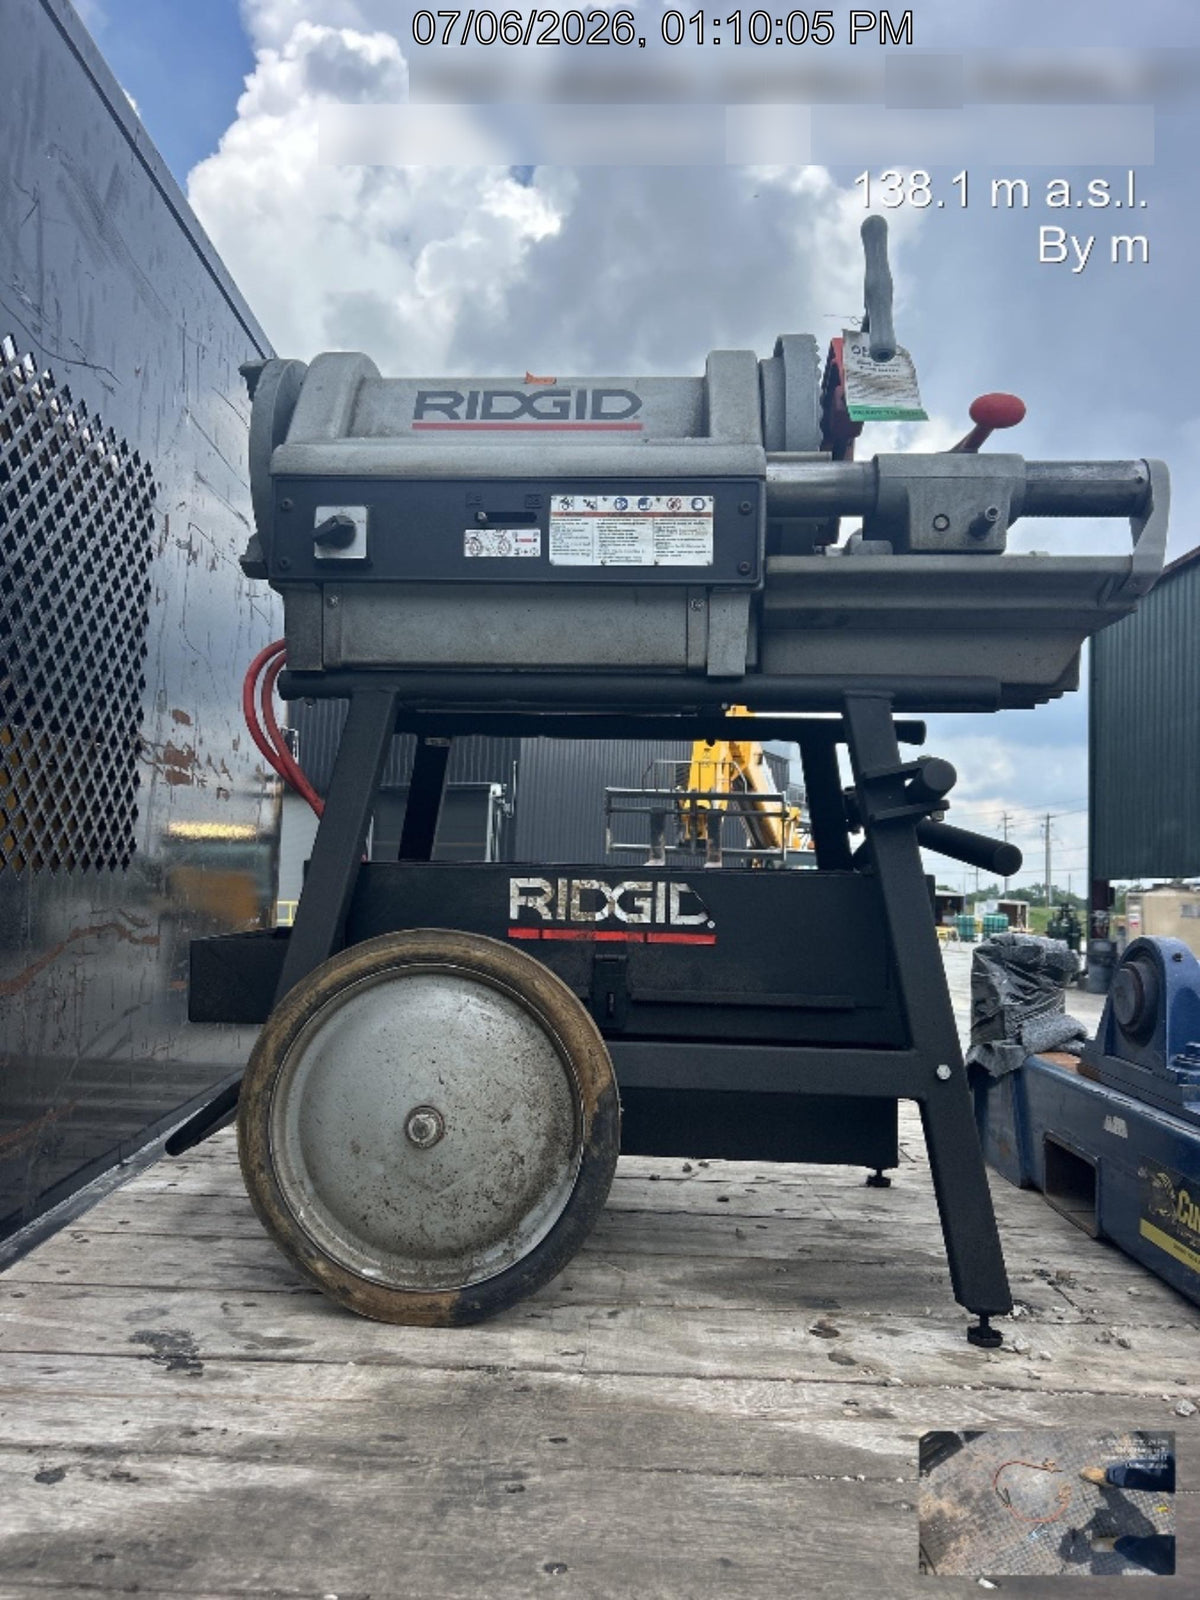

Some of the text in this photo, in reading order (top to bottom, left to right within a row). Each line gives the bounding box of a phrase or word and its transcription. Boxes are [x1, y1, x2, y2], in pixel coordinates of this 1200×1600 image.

[413, 389, 642, 420] RIDGID
[509, 877, 714, 927] RIDGID
[1176, 1189, 1200, 1233] Cu
